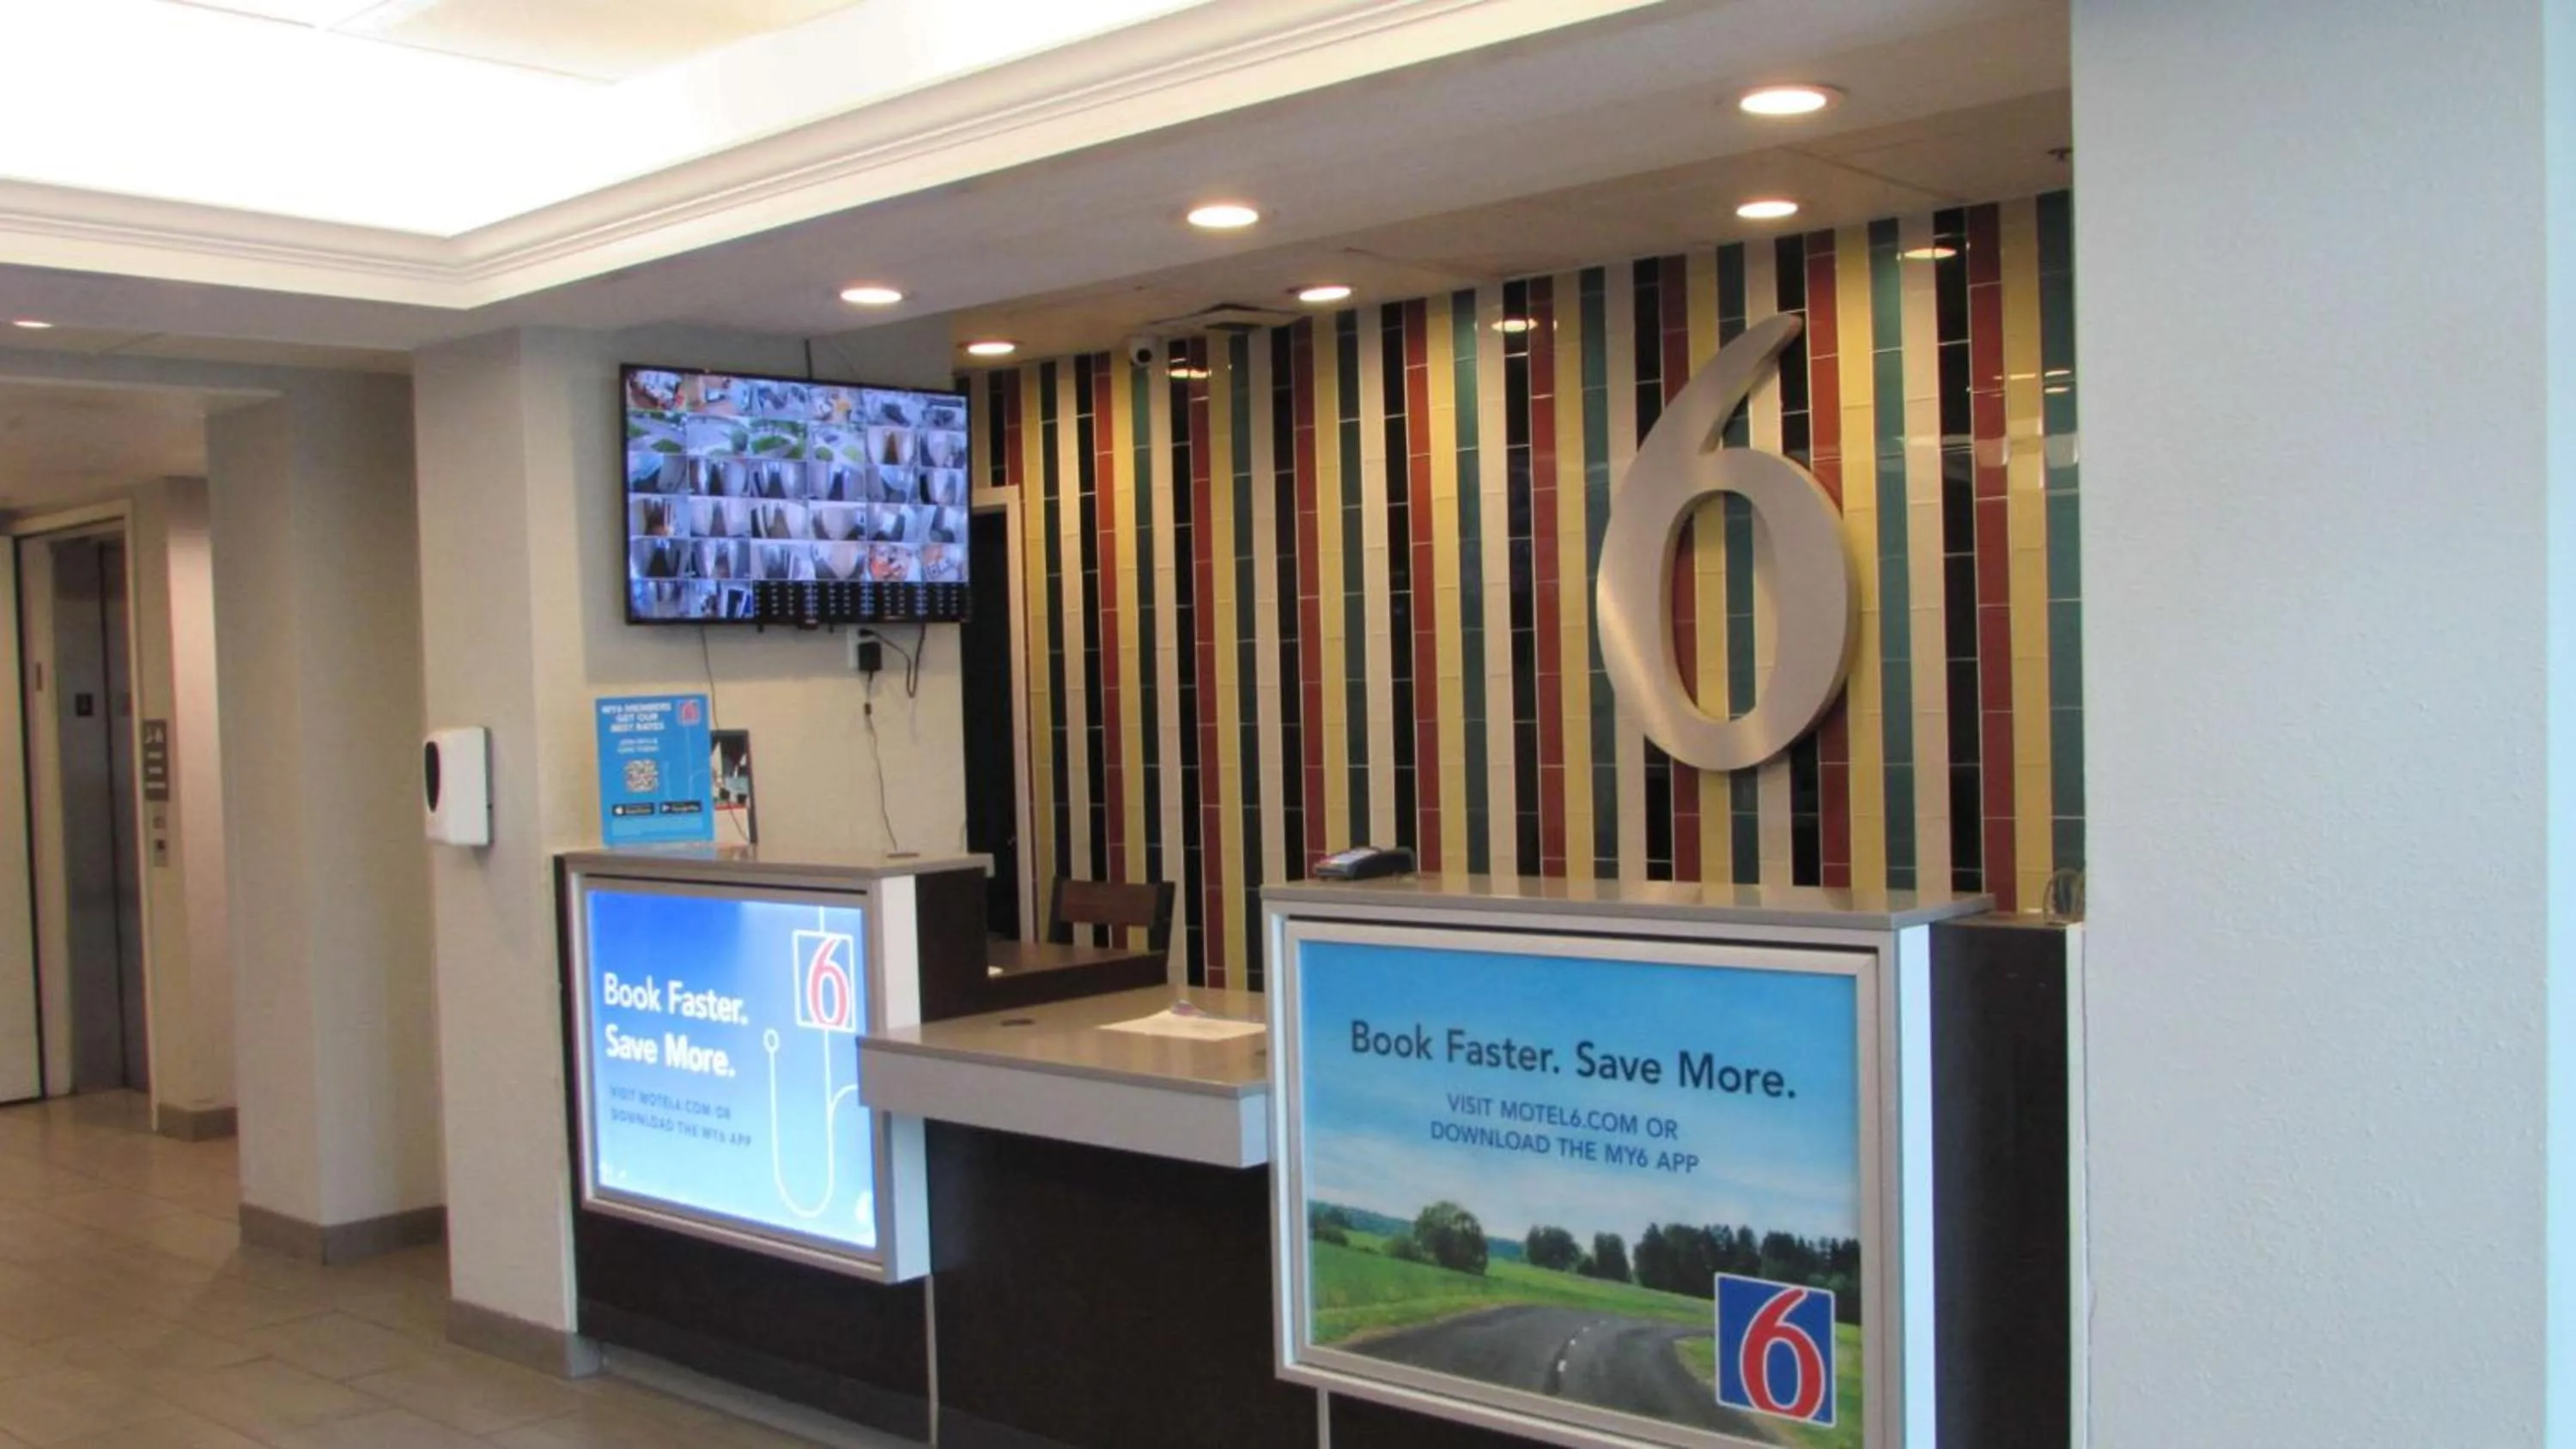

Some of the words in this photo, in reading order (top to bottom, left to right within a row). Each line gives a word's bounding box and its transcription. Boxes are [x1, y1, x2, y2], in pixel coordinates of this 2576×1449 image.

[1596, 312, 1862, 772] 6
[603, 972, 661, 1013] Book
[667, 979, 749, 1026] Faster.
[806, 937, 852, 1029] 6
[605, 1024, 659, 1064] Save
[665, 1033, 737, 1078] More.
[1351, 1019, 1433, 1062] Book
[1446, 1028, 1561, 1075] Faster.
[1574, 1040, 1662, 1085] Save
[1678, 1049, 1798, 1099] More.
[611, 1107, 673, 1132] DOWNLOAD
[677, 1119, 698, 1137] THE
[729, 1132, 752, 1148] APP
[715, 1105, 732, 1119] OR
[1447, 1092, 1494, 1116] VISIT
[1500, 1100, 1638, 1135] MOTEL6.COM
[1645, 1116, 1679, 1140] OR
[1431, 1121, 1550, 1155] DOWNLOAD
[1558, 1137, 1598, 1161] THE
[1604, 1143, 1649, 1168] MY6
[1656, 1151, 1699, 1174] APP
[1739, 1288, 1826, 1422] 6
